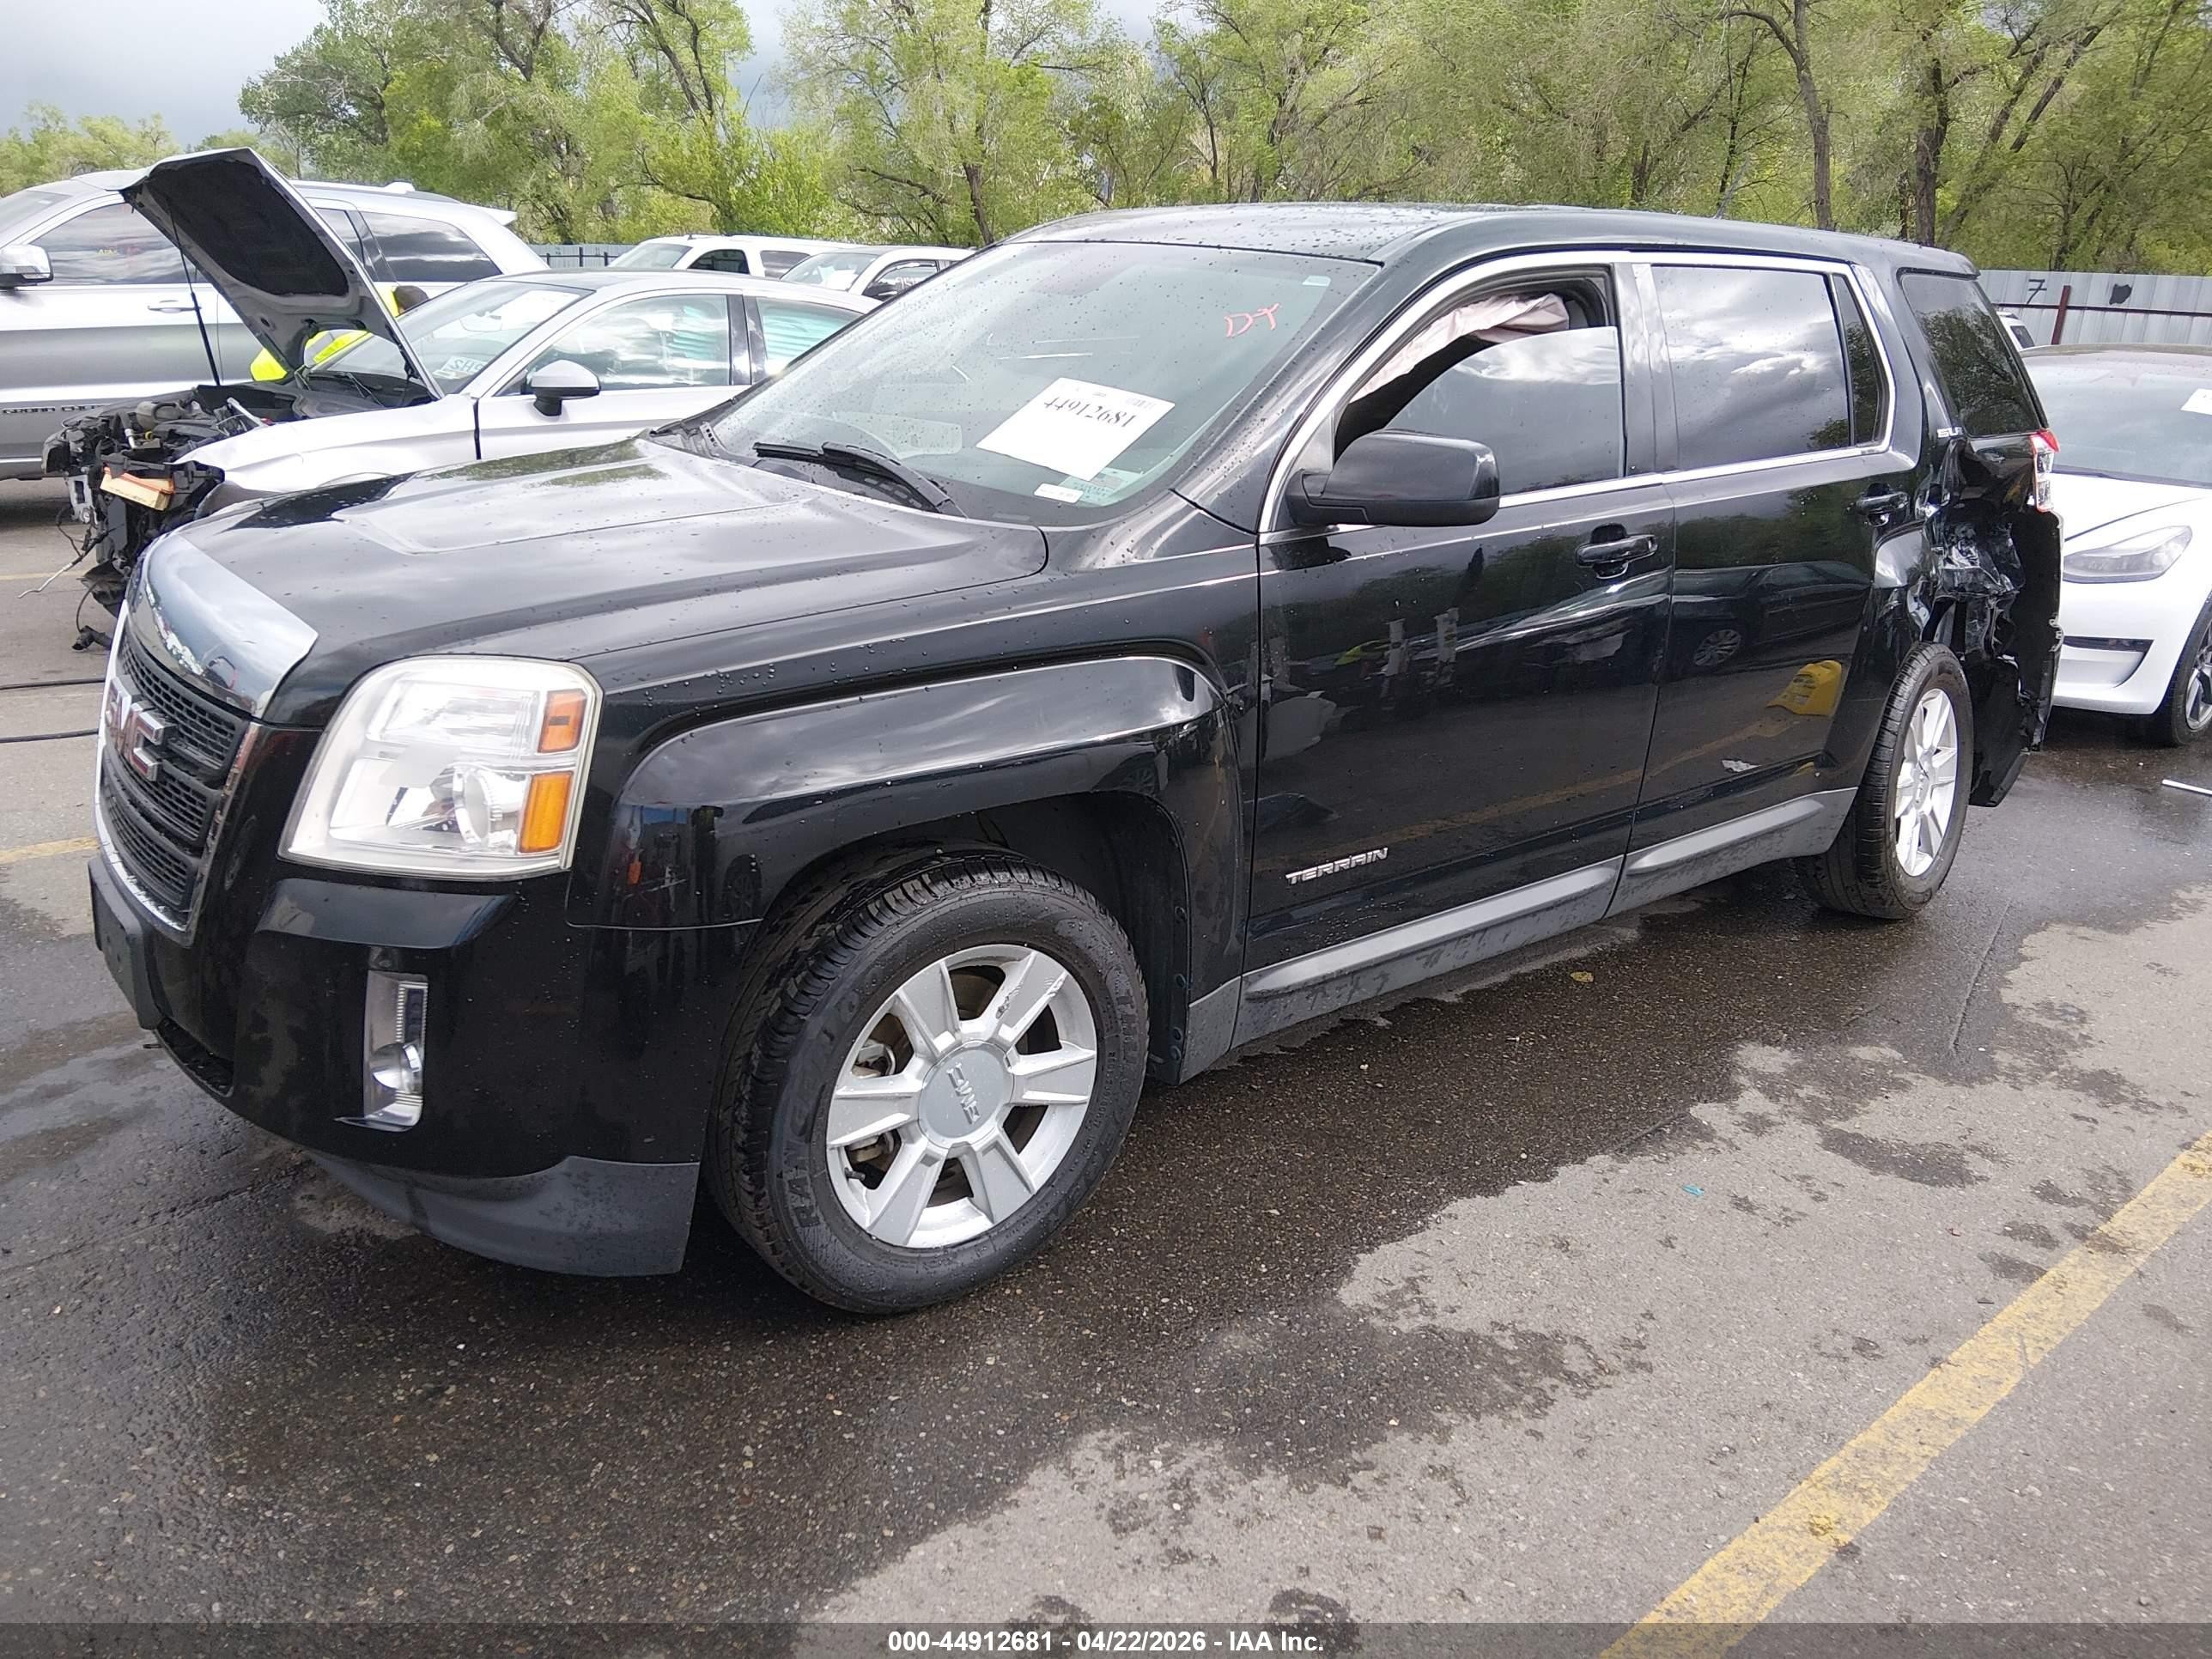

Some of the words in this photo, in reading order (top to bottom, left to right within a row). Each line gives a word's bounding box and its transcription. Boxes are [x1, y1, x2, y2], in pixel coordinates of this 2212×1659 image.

[2027, 278, 2047, 304] 7
[1044, 397, 1137, 428] 44912681
[1285, 847, 1389, 884] TERRAIN
[946, 1062, 981, 1125] GMC
